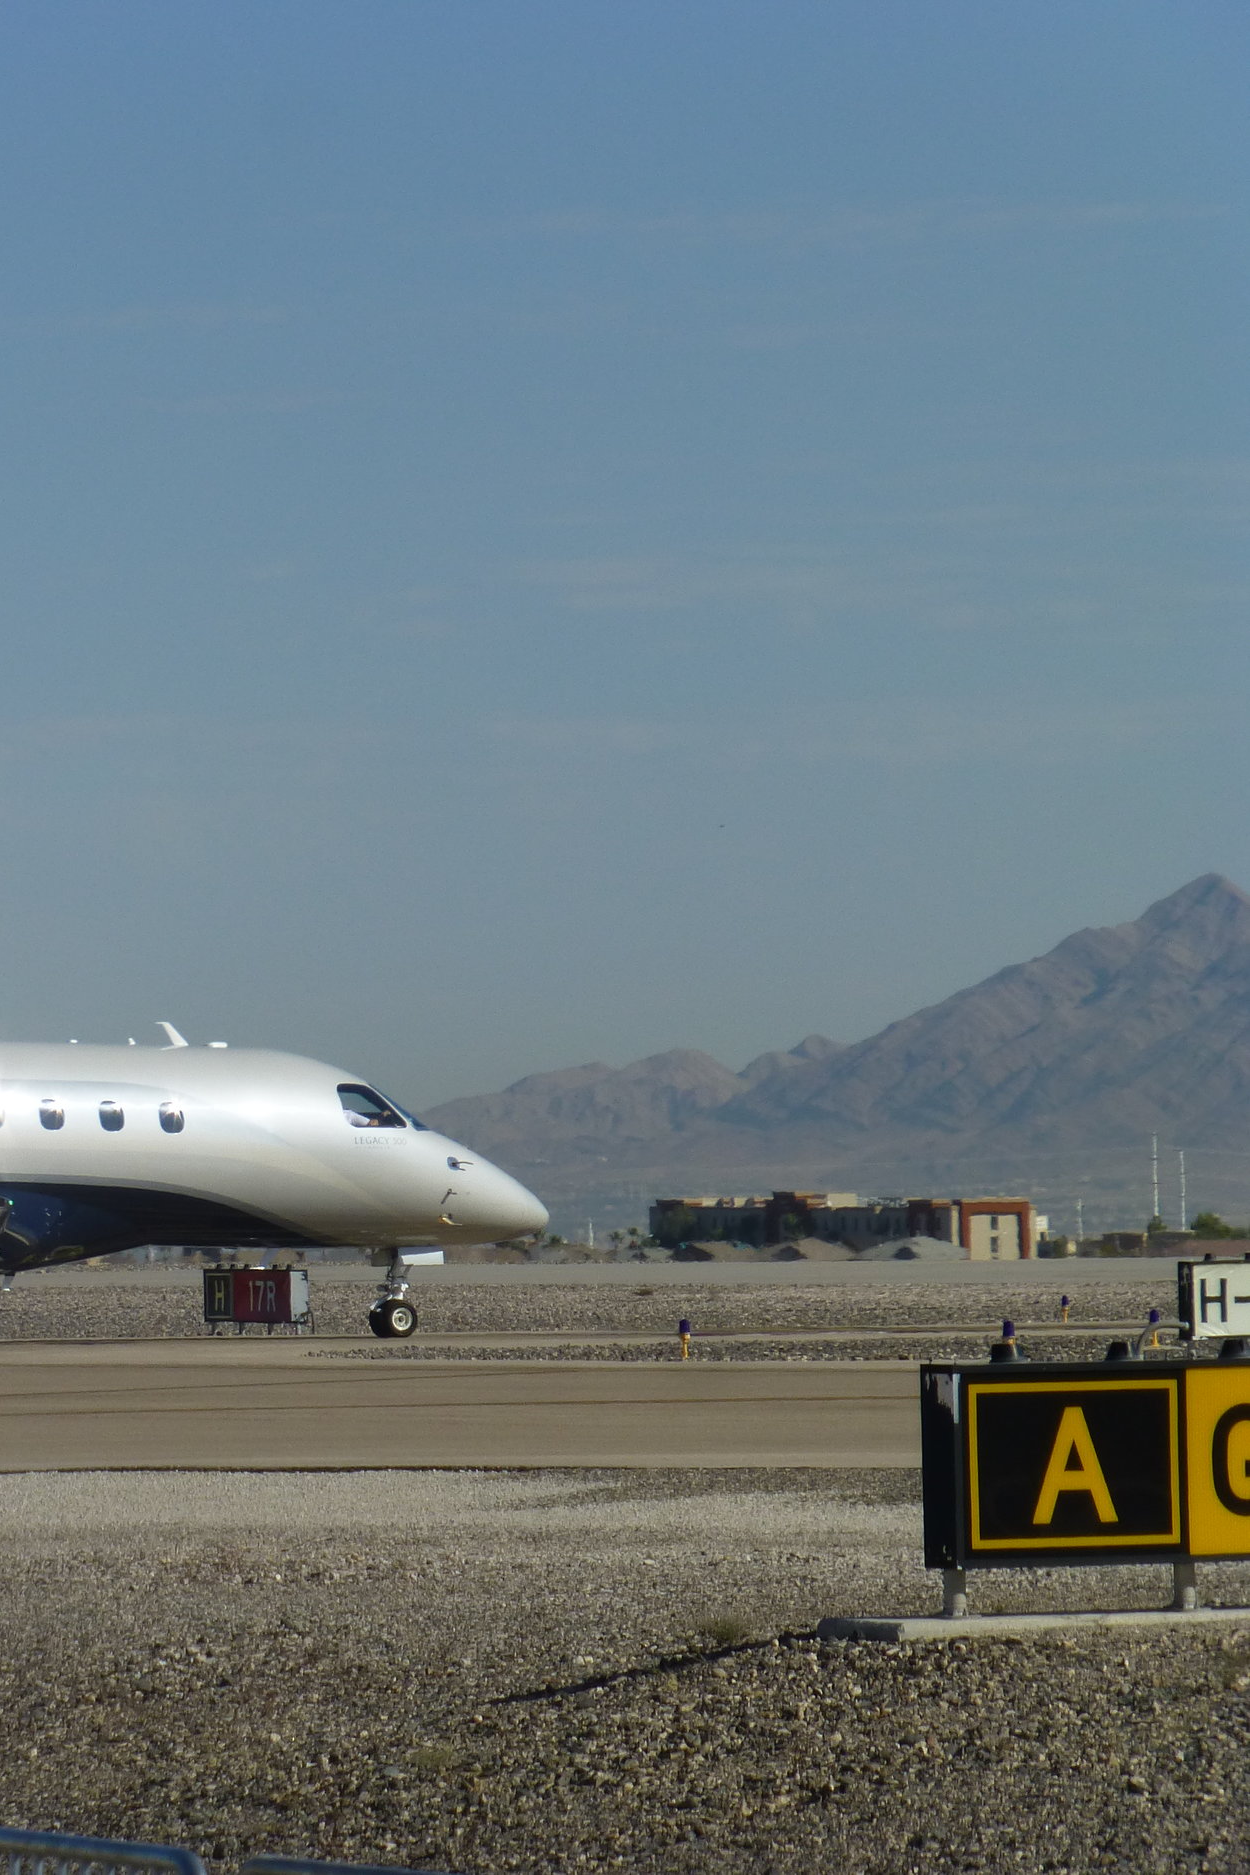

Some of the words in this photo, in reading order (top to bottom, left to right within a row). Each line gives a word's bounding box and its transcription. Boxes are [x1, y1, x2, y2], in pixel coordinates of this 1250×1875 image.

[354, 1136, 390, 1145] LEGACY
[214, 1279, 225, 1312] H
[248, 1280, 276, 1312] 17R
[1032, 1406, 1119, 1525] A
